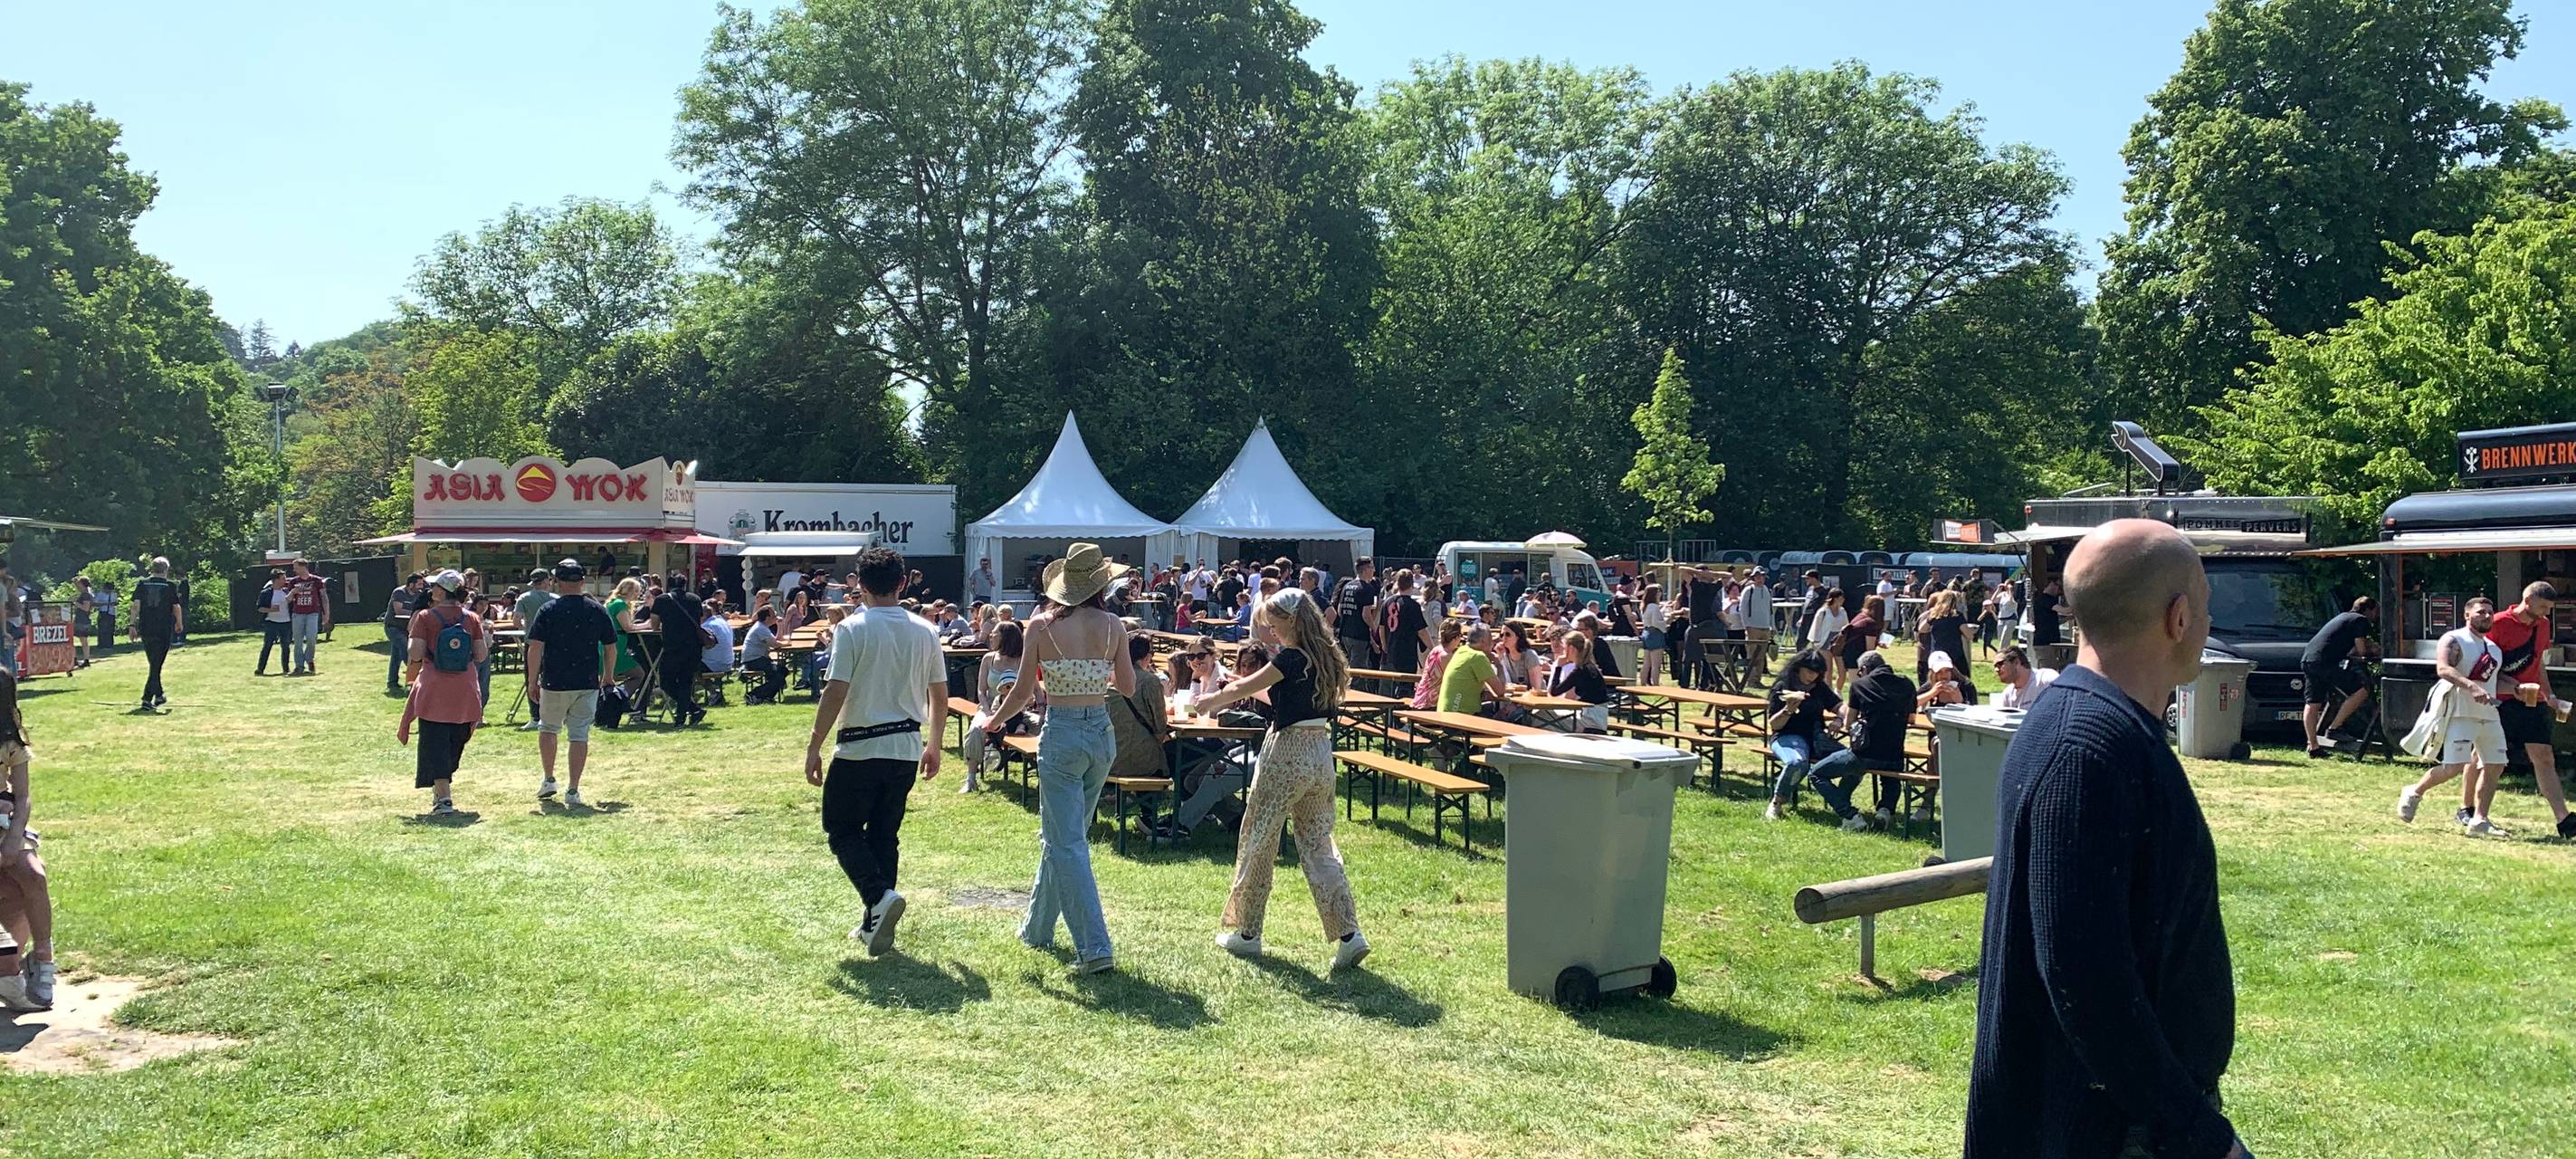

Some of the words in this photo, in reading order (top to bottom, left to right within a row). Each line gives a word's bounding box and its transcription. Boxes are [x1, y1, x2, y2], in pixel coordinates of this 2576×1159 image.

[2482, 441, 2576, 470] BRENNWERK
[424, 473, 505, 502] ASIA
[565, 474, 648, 502] WOK
[1388, 601, 1400, 632] 8
[33, 625, 70, 644] BREZEL
